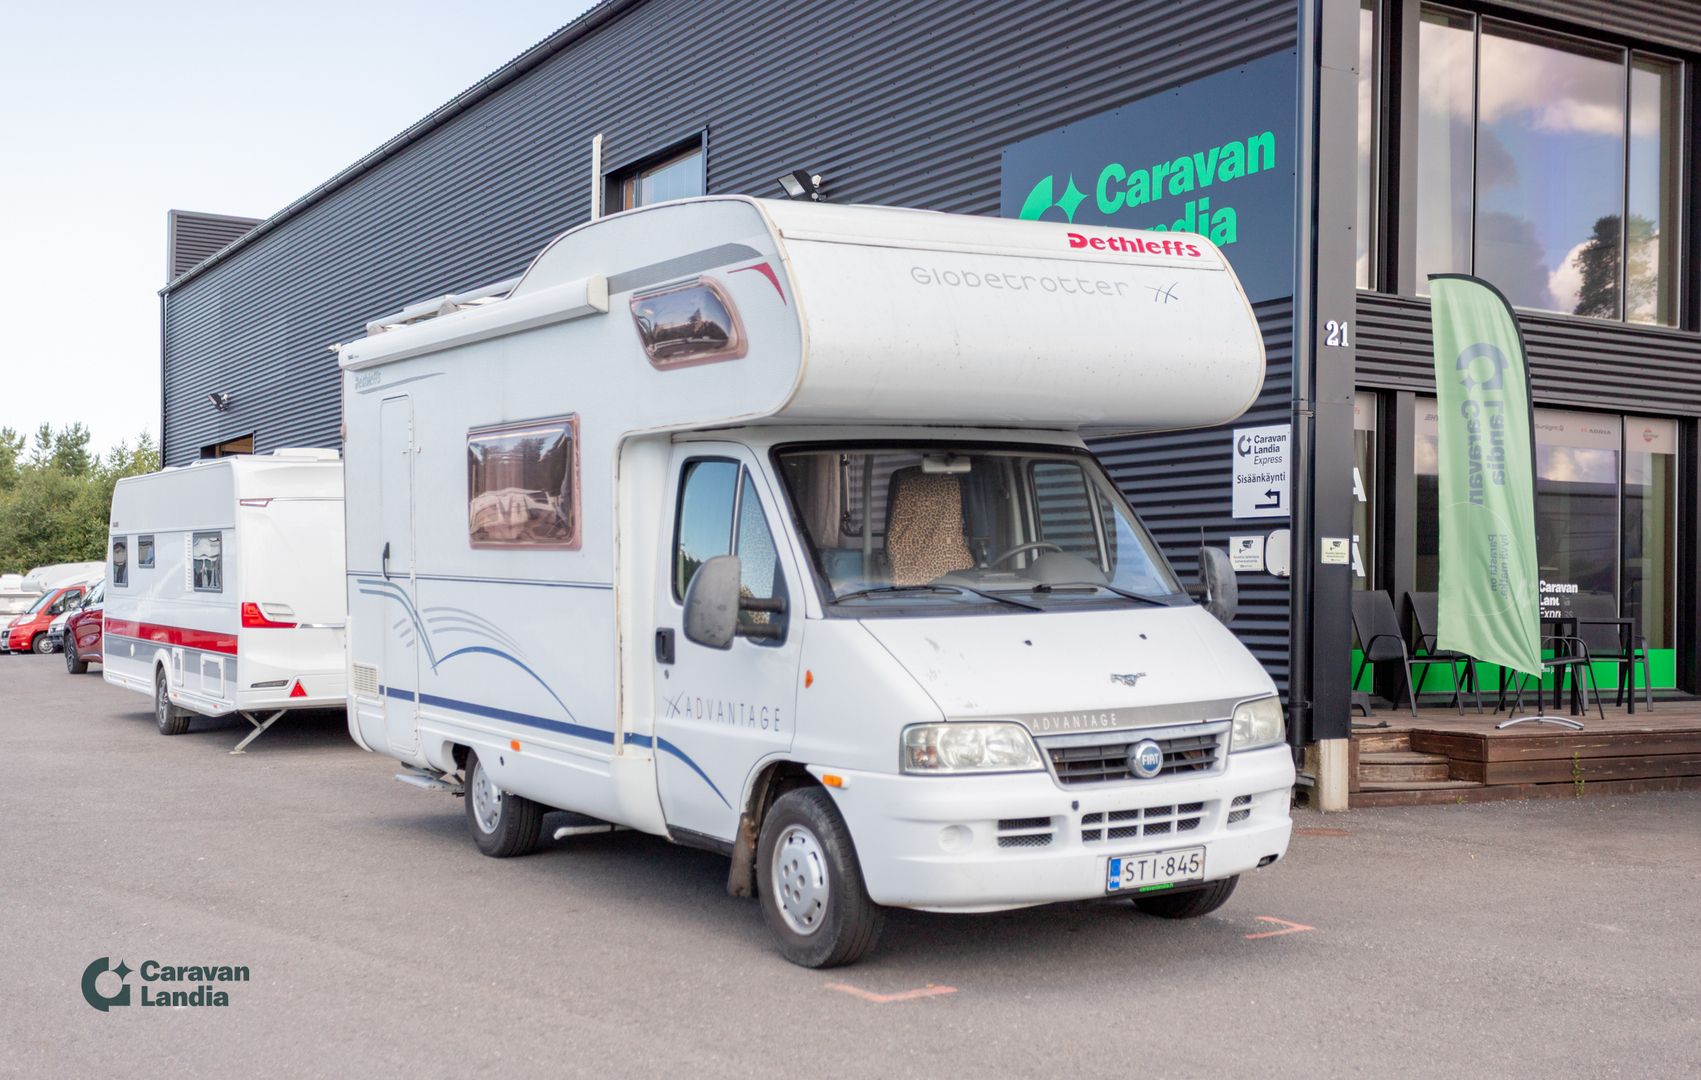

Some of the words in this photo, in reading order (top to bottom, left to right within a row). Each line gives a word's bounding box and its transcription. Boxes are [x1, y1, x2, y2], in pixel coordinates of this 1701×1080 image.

[1096, 131, 1276, 215] Caravan
[1067, 232, 1201, 257] Dethleffs
[910, 266, 1128, 296] Globetrotter
[1325, 320, 1349, 347] 21
[1254, 434, 1287, 444] Caravan
[1254, 443, 1280, 454] Landia
[1253, 455, 1283, 466] Express
[1237, 472, 1286, 484] Sisäänkäynti
[1540, 580, 1579, 593] Caravan
[686, 697, 780, 732] ADVANTAGE
[1033, 713, 1118, 730] ADVANTAGE
[1142, 753, 1159, 767] FIAT
